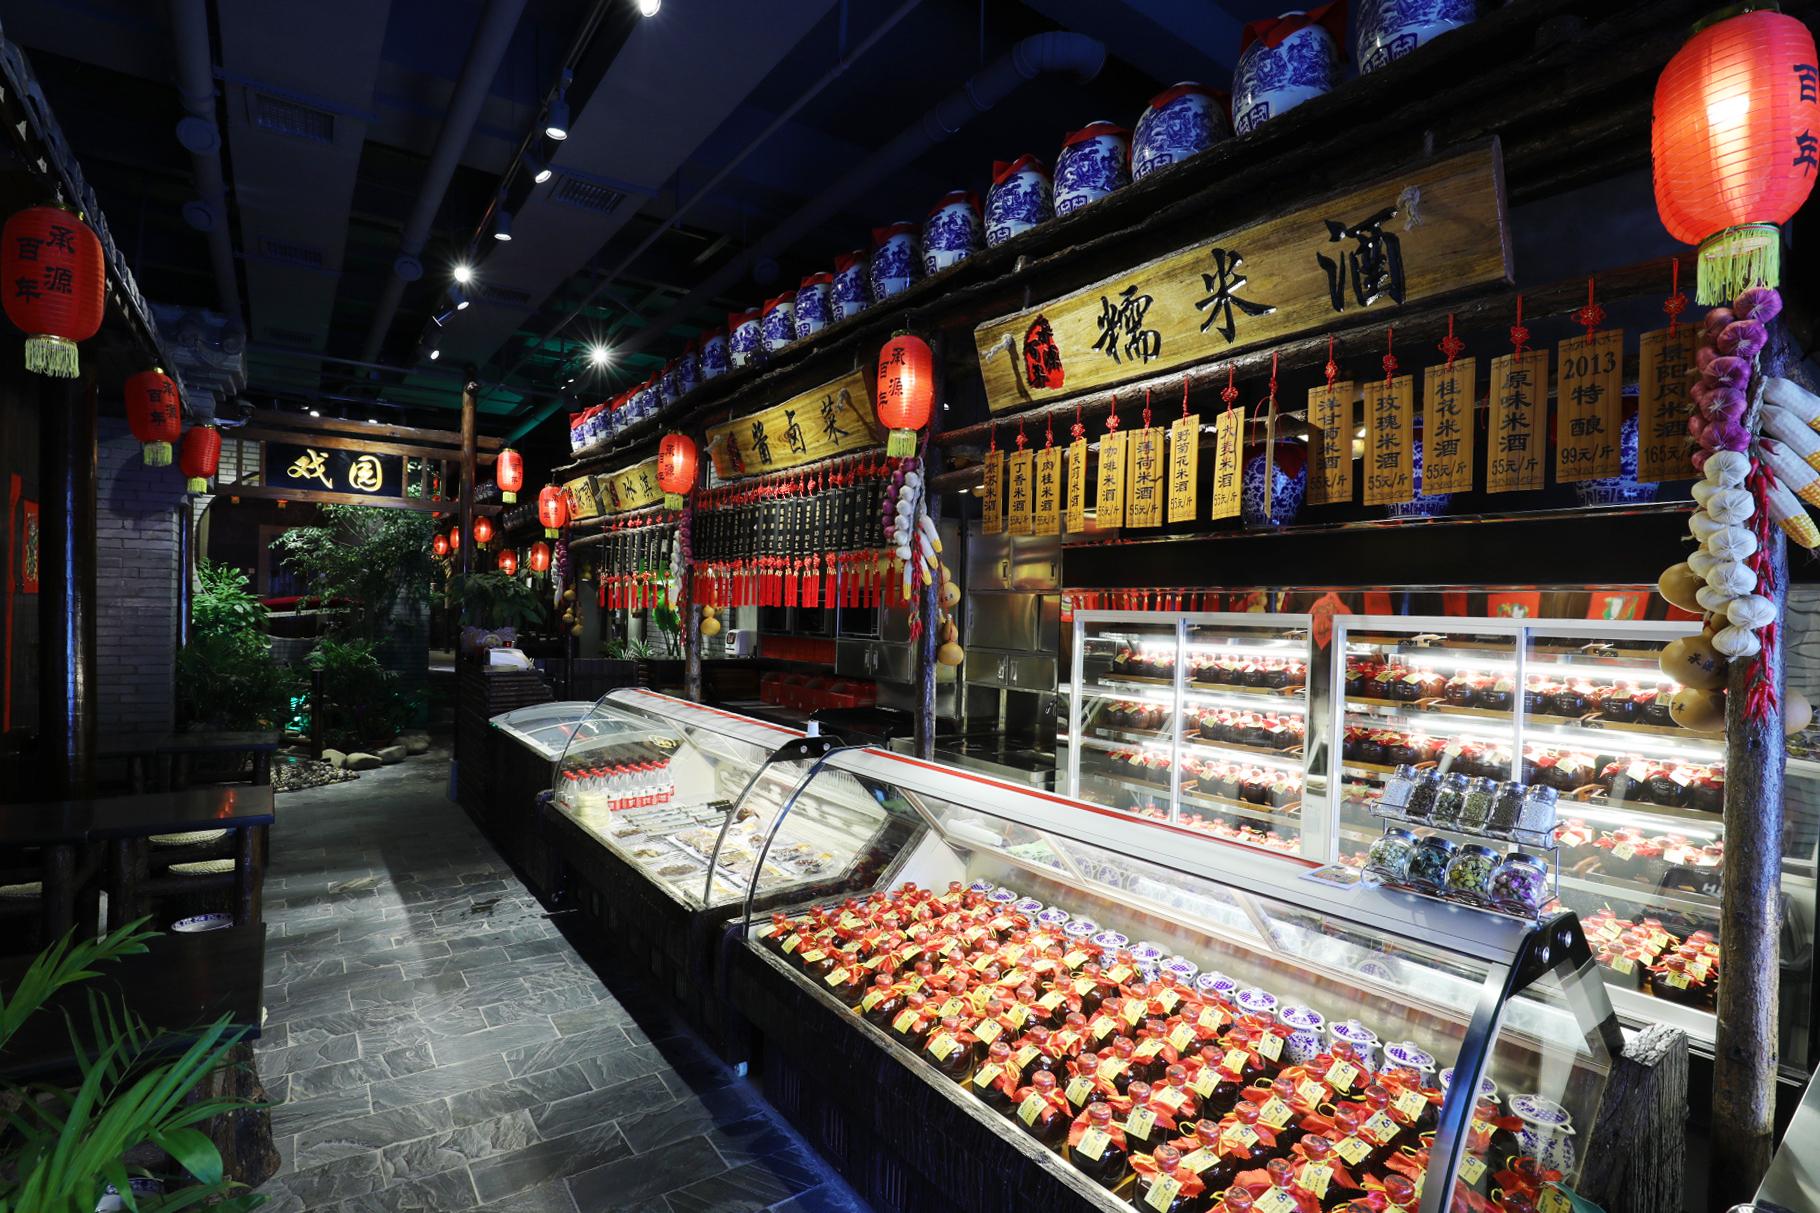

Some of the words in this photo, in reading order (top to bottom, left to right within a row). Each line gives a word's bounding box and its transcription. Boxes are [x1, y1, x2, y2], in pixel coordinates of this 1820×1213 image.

[15, 236, 44, 304] 百年
[44, 224, 76, 295] 承源
[1091, 206, 1407, 365] 糯米酒
[888, 347, 906, 396] 承源
[1564, 352, 1616, 380] 2013
[1375, 394, 1401, 470] 玫瑰米酒
[1434, 378, 1462, 457] 桂花米酒
[1499, 369, 1533, 452] 原味米酒
[1570, 383, 1605, 437] 特酿
[286, 448, 383, 492] 戏园
[1103, 446, 1117, 501] 咖啡米酒
[1136, 441, 1154, 500] 薄荷米酒
[1176, 430, 1190, 492] 野菊花米酒
[1426, 463, 1467, 480] 55元/斤
[1491, 457, 1538, 475] 55元/斤
[1561, 443, 1615, 464] 99元/斤
[1013, 462, 1026, 511] 丁香米酒
[1041, 460, 1054, 511] 肉桂米酒
[1368, 474, 1408, 490] 55元/斤
[1130, 503, 1158, 516] 55元/斤
